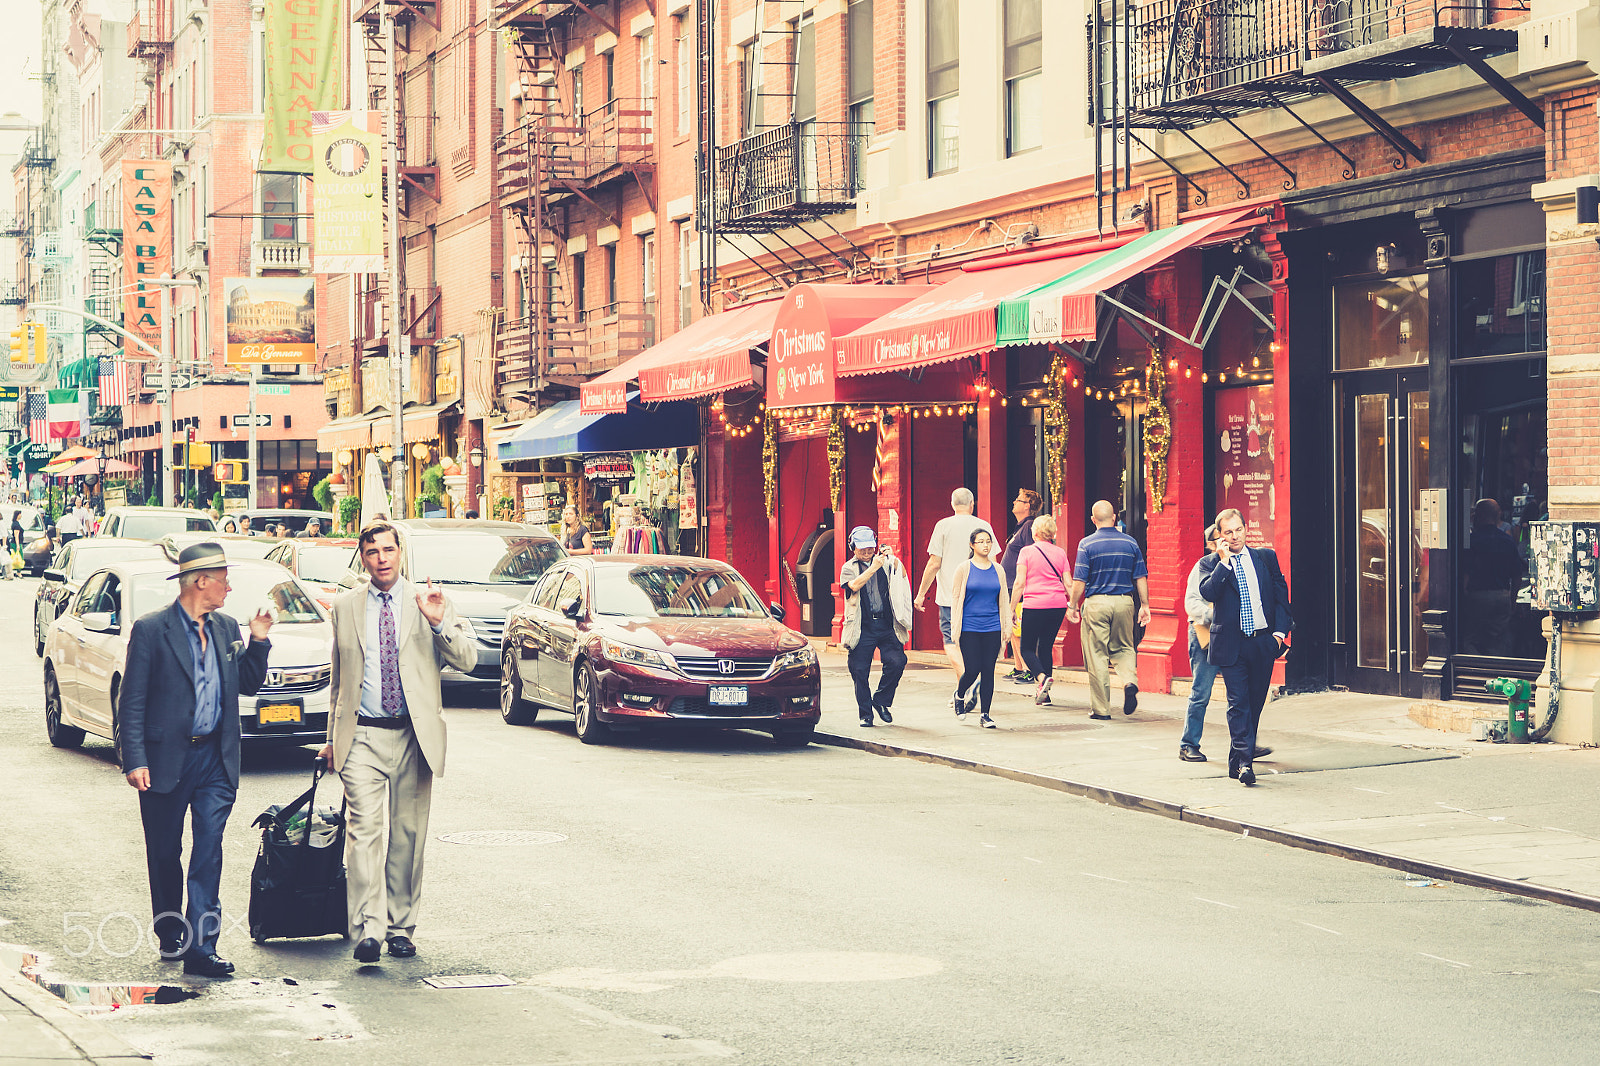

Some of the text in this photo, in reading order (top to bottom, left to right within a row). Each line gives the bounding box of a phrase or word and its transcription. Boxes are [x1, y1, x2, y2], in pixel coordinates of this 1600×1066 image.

[285, 0, 320, 161] GENNARO
[316, 183, 378, 194] WELCOME
[135, 168, 156, 233] CASA
[317, 198, 331, 209] TO
[318, 210, 375, 222] HISTORIC
[318, 225, 360, 237] LITTLE
[318, 240, 353, 251] ITALY
[1033, 310, 1058, 334] Claus
[240, 344, 303, 360] Da Gennaro
[774, 328, 826, 363] Christmas
[875, 338, 911, 364] Christmas
[920, 334, 936, 357] New
[936, 331, 950, 351] York
[667, 373, 691, 394] Christmas
[788, 366, 807, 392] New
[807, 362, 825, 386] York
[597, 464, 611, 472] NEW
[611, 464, 628, 472] YORK
